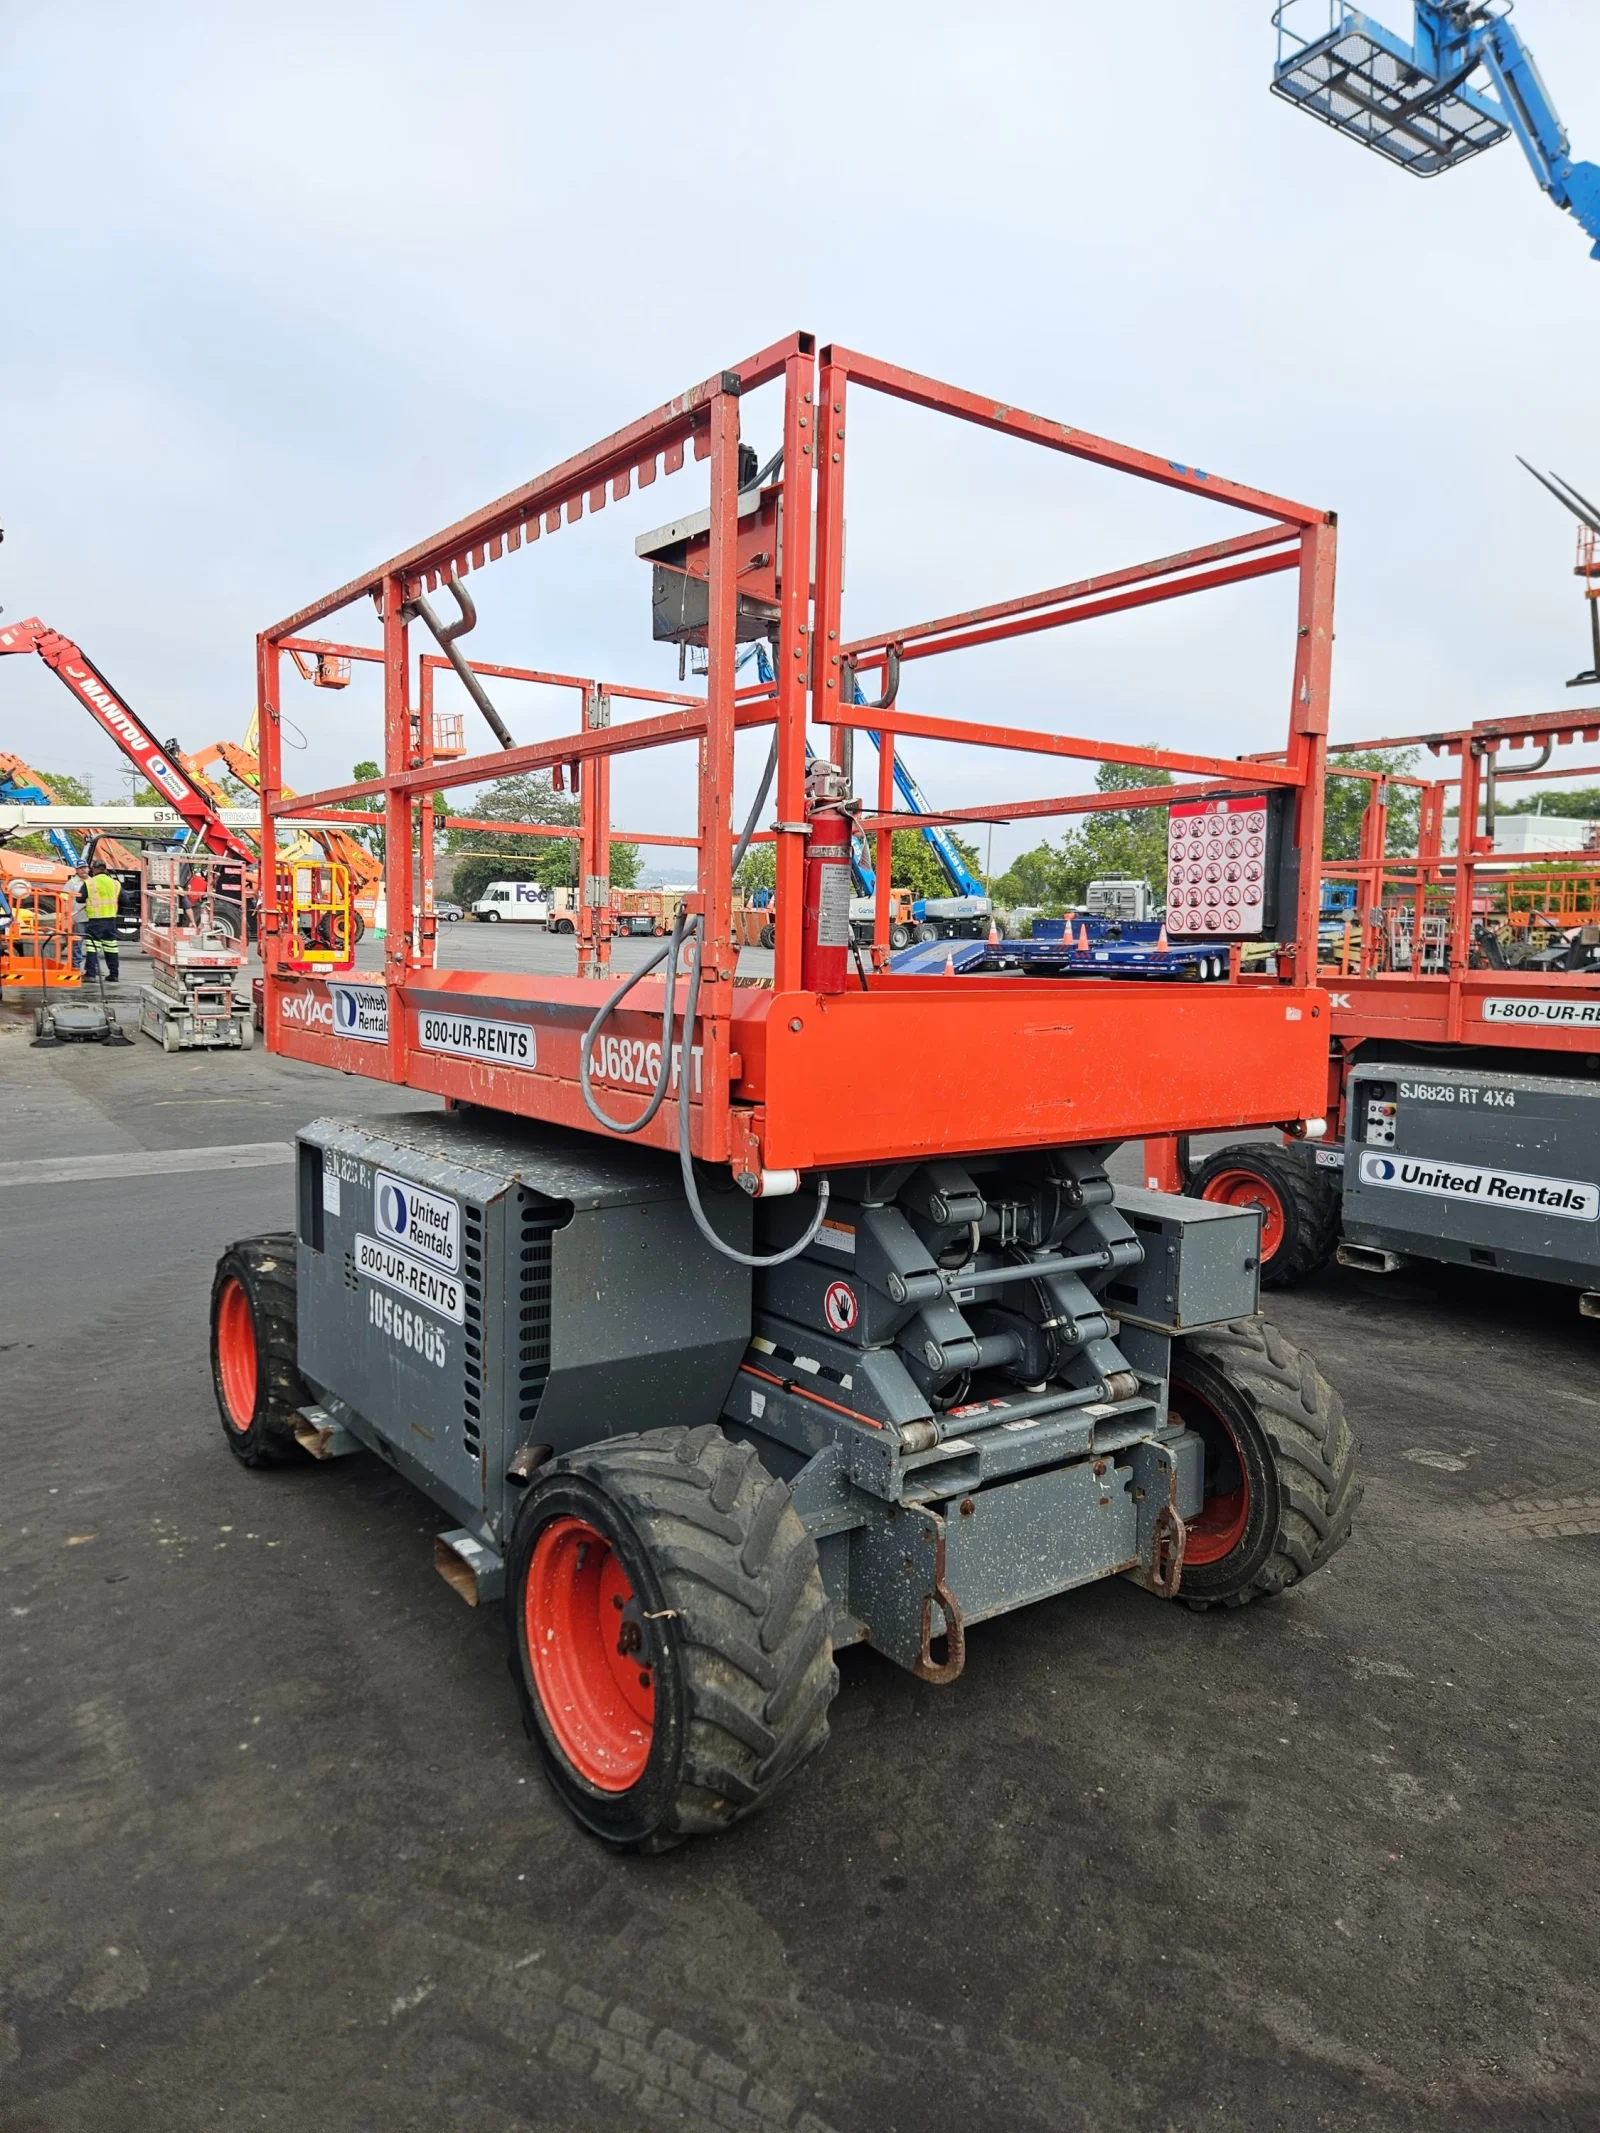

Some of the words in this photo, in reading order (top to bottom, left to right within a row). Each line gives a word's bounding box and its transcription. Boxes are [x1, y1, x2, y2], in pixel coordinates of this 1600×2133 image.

[79, 678, 151, 751] MANITOU
[162, 777, 182, 799] Rentals
[167, 773, 185, 793] United
[282, 988, 333, 1026] SKYJAC
[355, 992, 386, 1011] United
[424, 1019, 529, 1059] 800-UR-RENTS
[1400, 1083, 1455, 1102] SJ6826
[1460, 1088, 1479, 1104] RT
[1483, 1090, 1516, 1107] 4X4
[1400, 1164, 1483, 1194] United
[1486, 1177, 1587, 1211] Rentals
[410, 1196, 450, 1232] United
[410, 1220, 454, 1260] Rentals
[361, 1245, 458, 1312] 800-UR-RENTS
